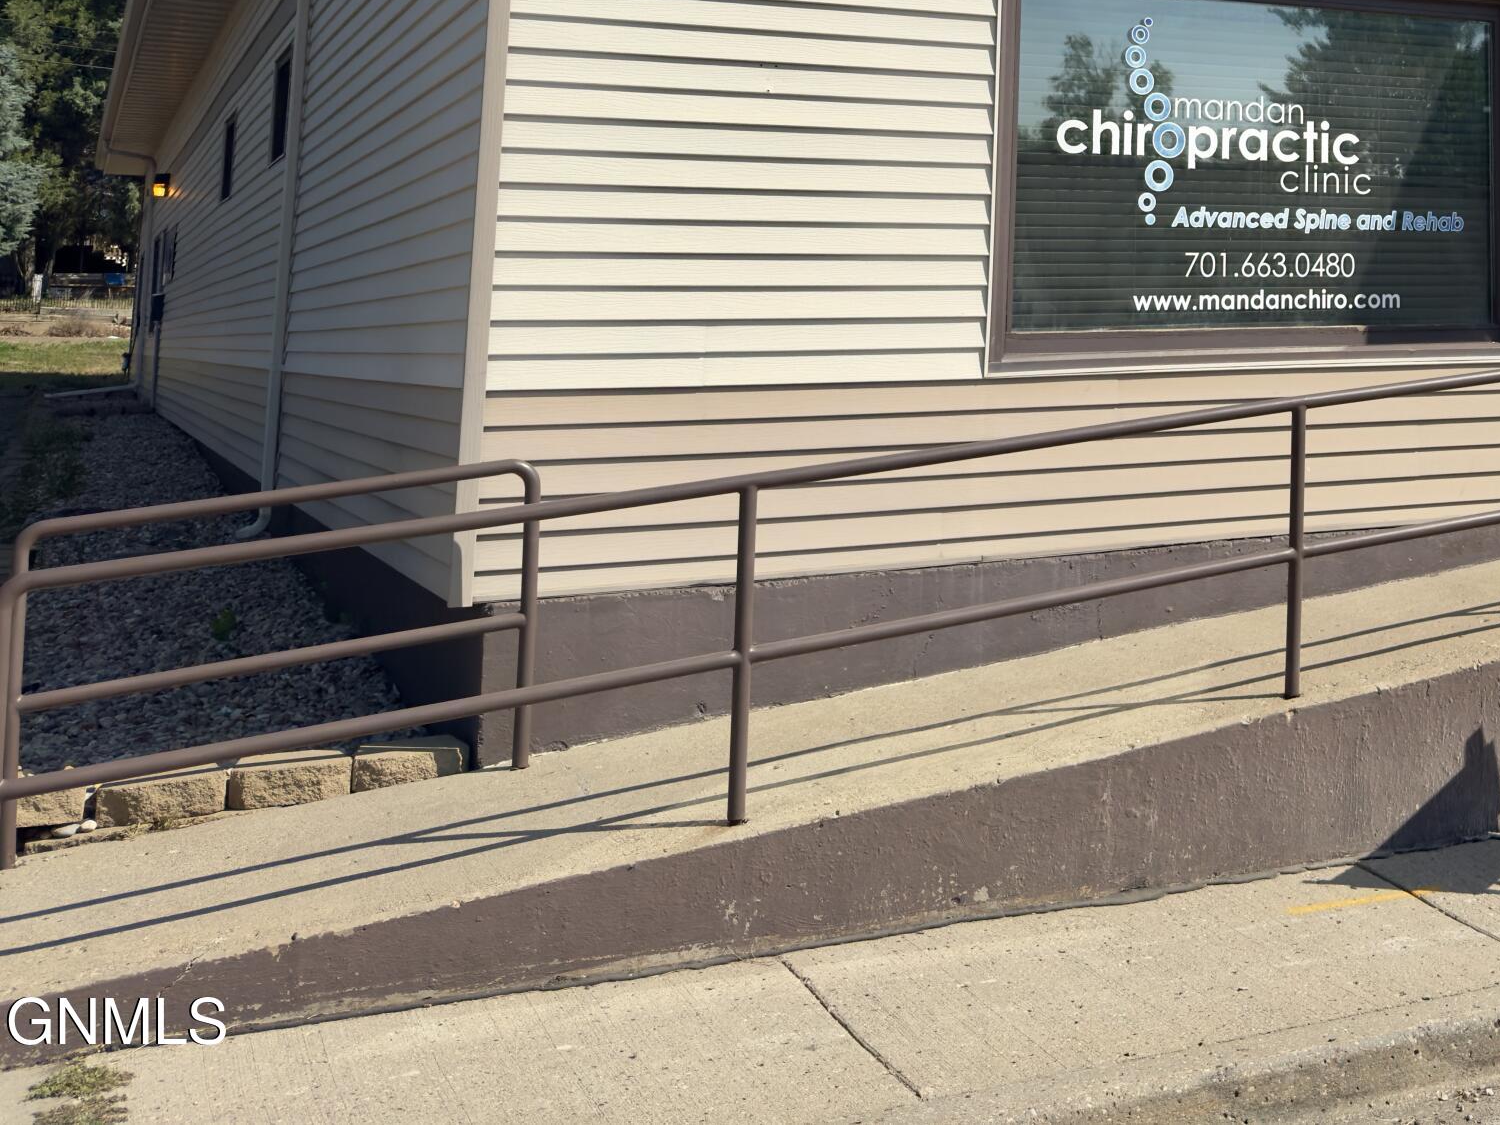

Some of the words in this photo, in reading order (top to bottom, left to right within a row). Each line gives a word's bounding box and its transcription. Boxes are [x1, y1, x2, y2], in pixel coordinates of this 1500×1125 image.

[1174, 96, 1304, 124] mandan
[1056, 109, 1360, 169] chiropractic
[1280, 165, 1372, 195] clinic
[1171, 206, 1291, 230] Advanced
[1293, 207, 1352, 234] Spine
[1357, 209, 1396, 232] and
[1402, 210, 1465, 233] Rehab
[1184, 252, 1356, 278] 701.663.0480
[1133, 289, 1401, 312] www.mandanchiro.com
